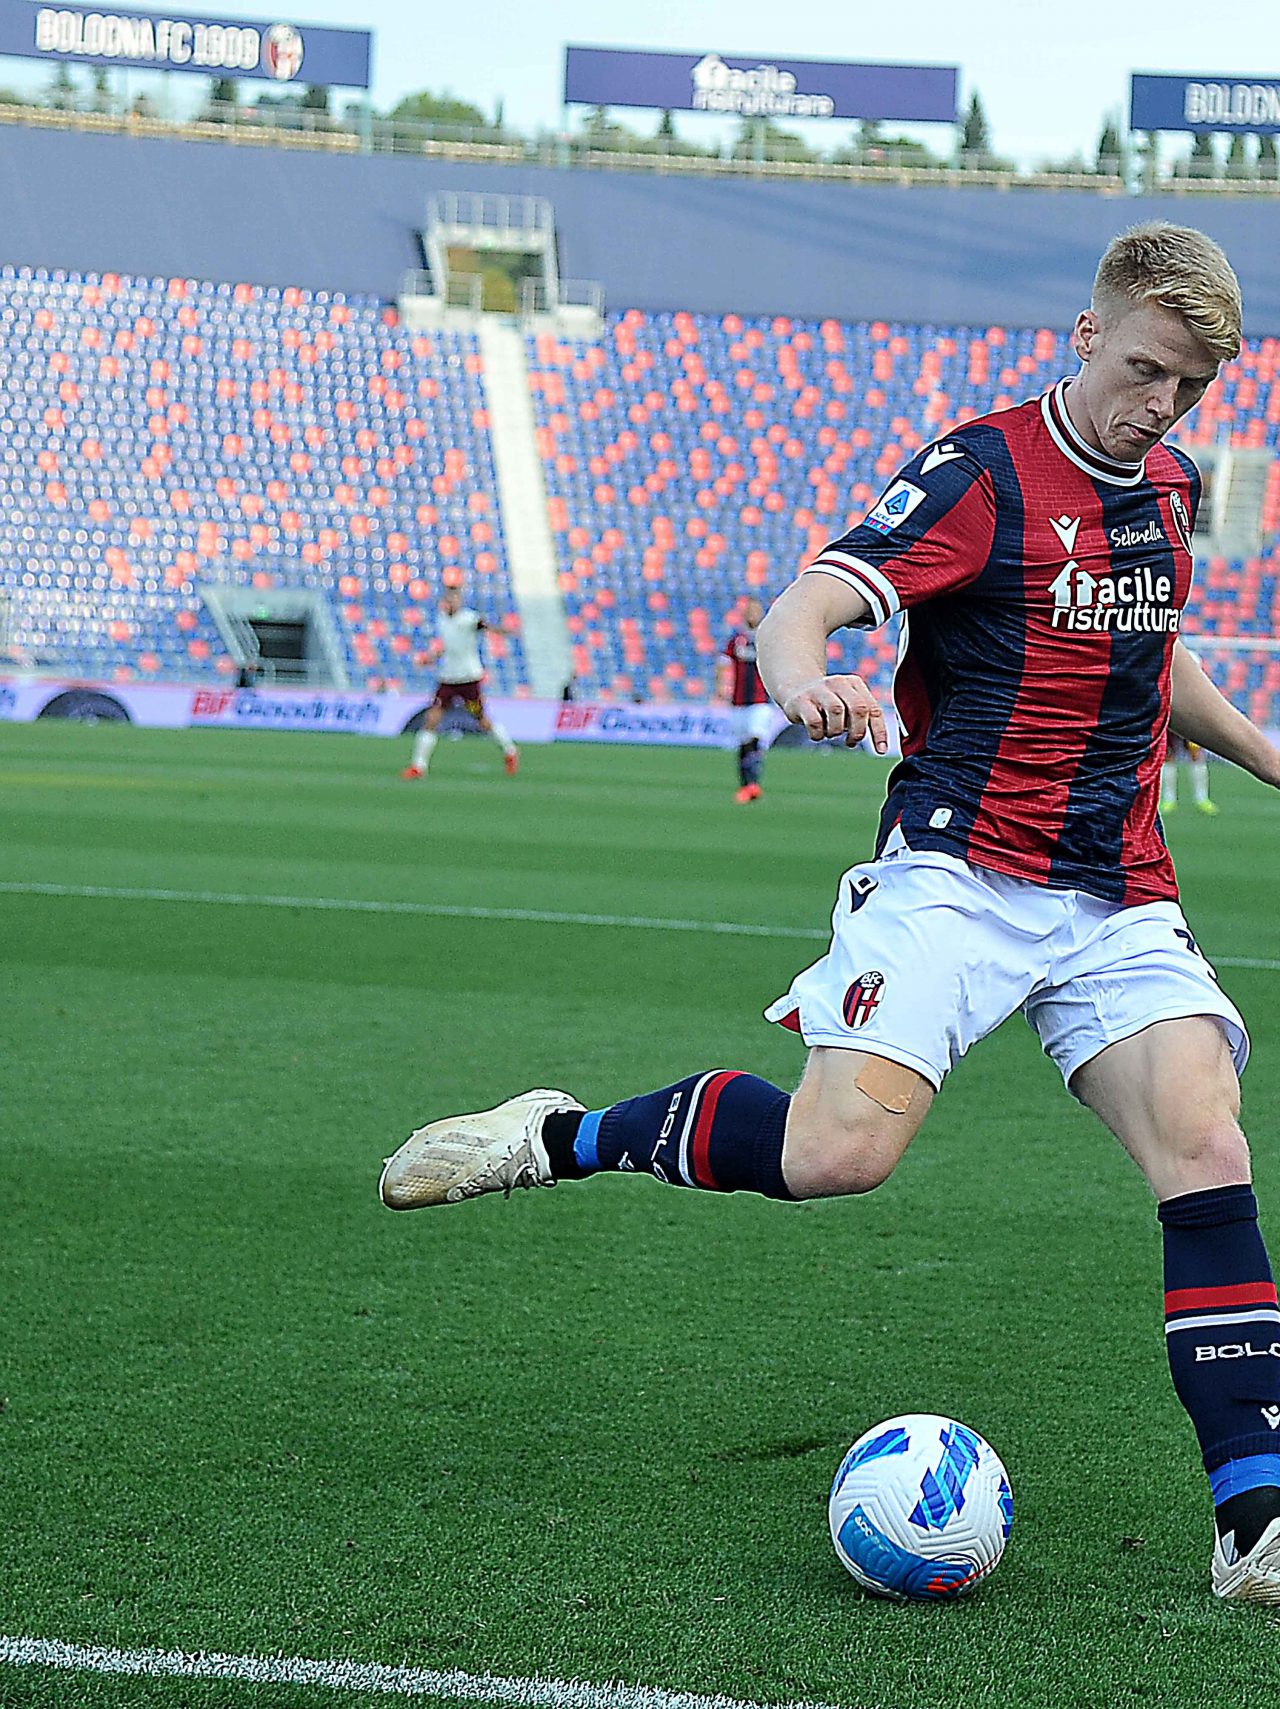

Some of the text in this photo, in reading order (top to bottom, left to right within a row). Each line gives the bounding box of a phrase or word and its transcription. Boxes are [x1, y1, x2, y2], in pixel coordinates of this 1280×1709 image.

[36, 8, 261, 70] BOLOGNA FC 1909
[1110, 520, 1165, 548] Selenella
[1047, 560, 1172, 608] facile
